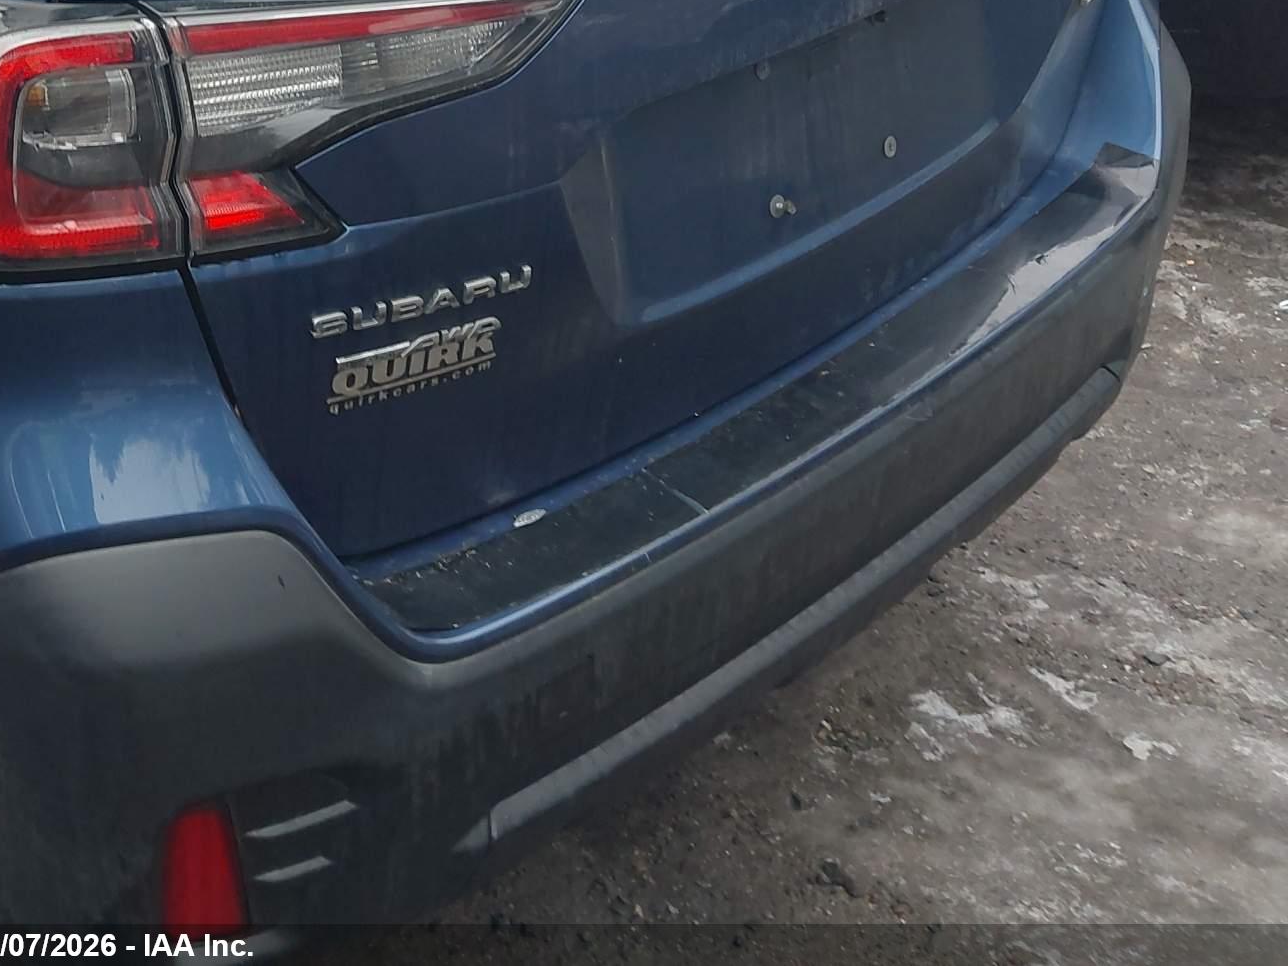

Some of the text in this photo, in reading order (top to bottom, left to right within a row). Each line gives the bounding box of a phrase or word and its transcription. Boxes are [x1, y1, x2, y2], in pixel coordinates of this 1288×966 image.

[310, 264, 533, 339] SUBARU
[328, 359, 492, 416] quirkcars.com
[331, 331, 496, 398] QUIRK
